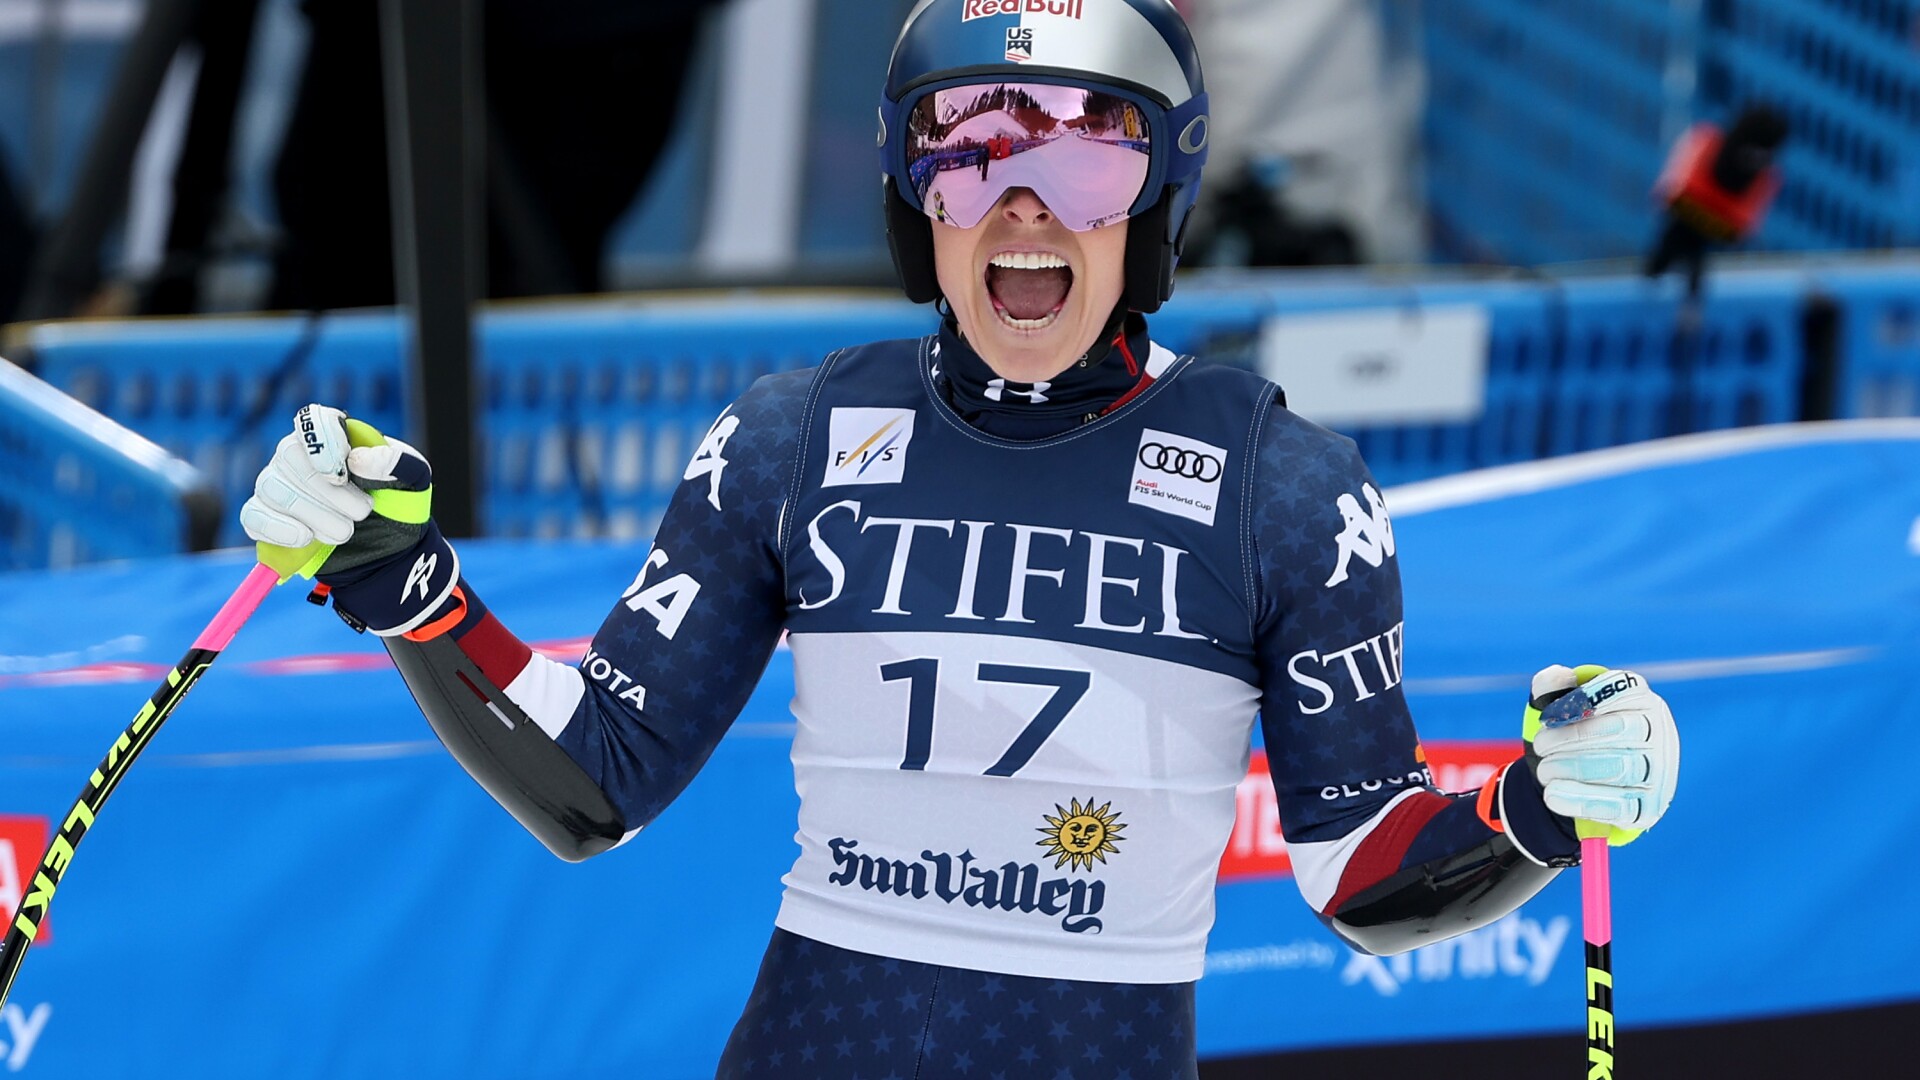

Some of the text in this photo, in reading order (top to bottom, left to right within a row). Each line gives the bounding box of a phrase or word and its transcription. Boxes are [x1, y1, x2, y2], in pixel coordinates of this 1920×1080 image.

[1007, 27, 1033, 40] US
[1134, 485, 1212, 511] FIS Ski World Cup
[1136, 478, 1158, 488] Audi
[621, 541, 702, 640] SA
[798, 499, 1219, 645] STIFEL
[878, 655, 1093, 778] 17
[1287, 621, 1404, 715] STIF
[15, 798, 95, 943] LEKI
[1586, 966, 1614, 1080] LEK
